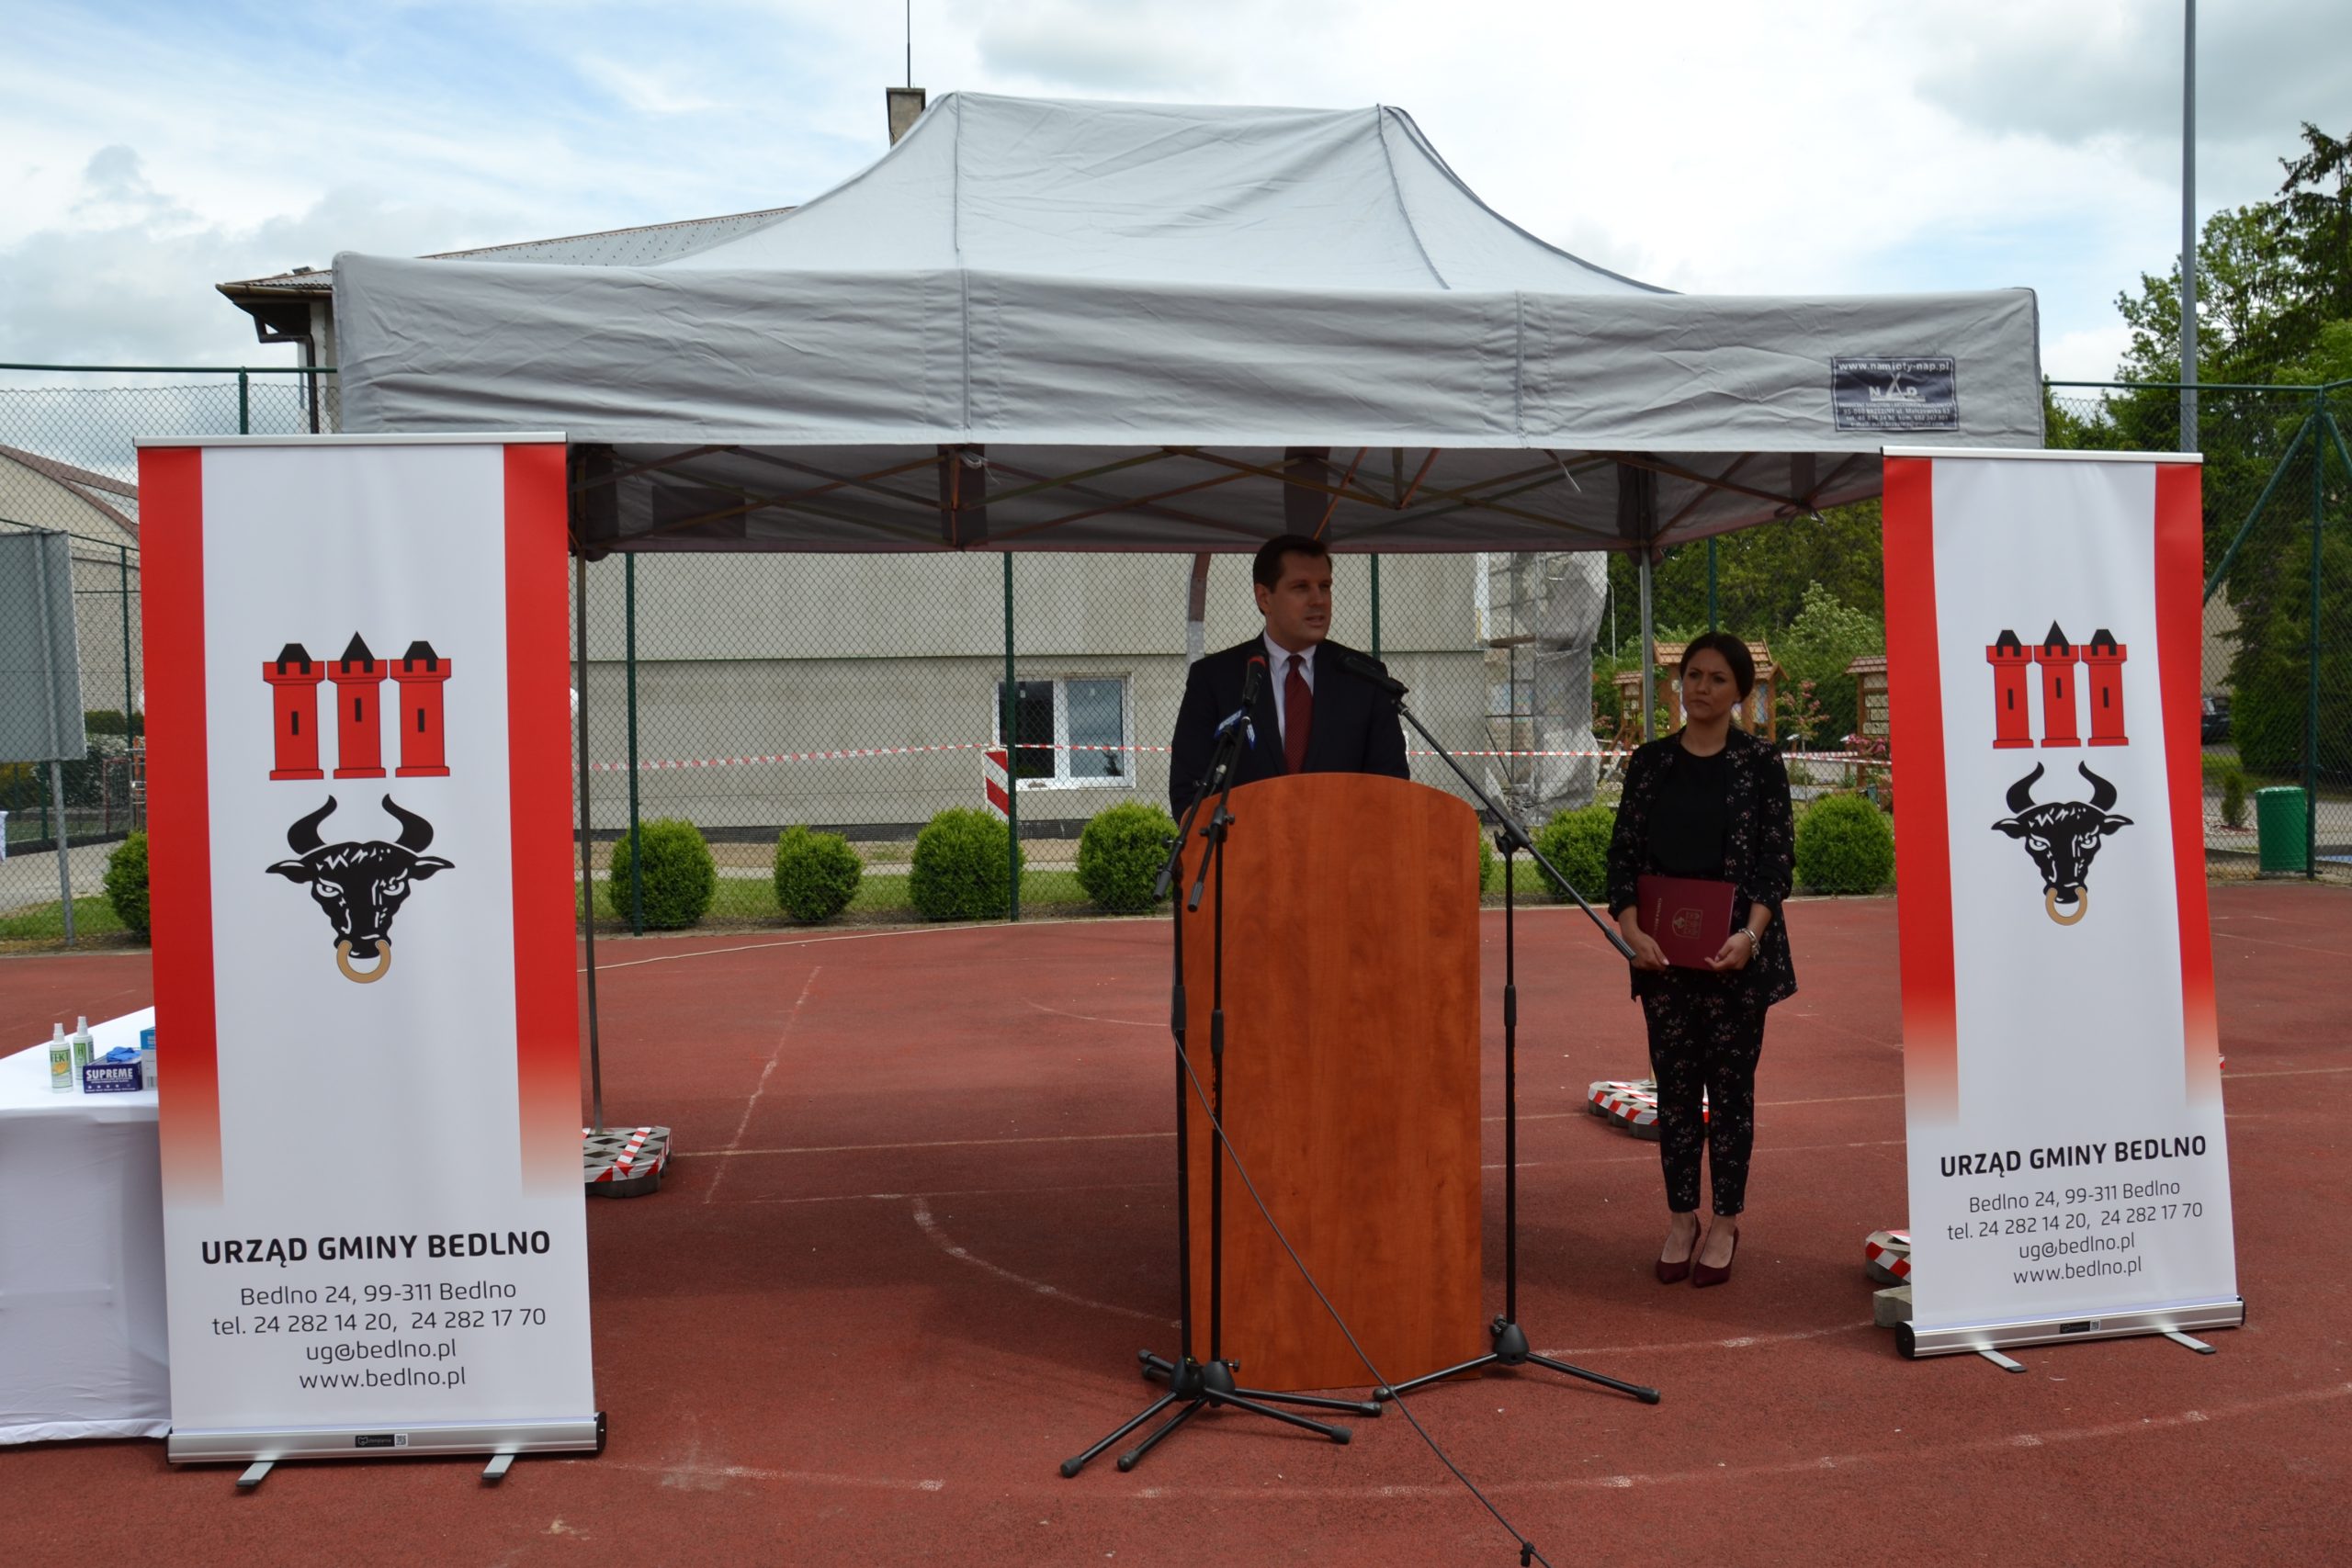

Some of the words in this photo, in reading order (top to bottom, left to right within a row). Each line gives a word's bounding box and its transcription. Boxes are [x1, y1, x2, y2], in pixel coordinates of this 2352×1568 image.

[85, 1067, 133, 1079] SUPREME
[1940, 1150, 2022, 1179] URZĄD
[2029, 1142, 2108, 1170] GMINY
[2114, 1134, 2207, 1163] BEDLNO
[1969, 1193, 2030, 1213] Bedlno
[2035, 1190, 2060, 1209] 24,
[2064, 1184, 2117, 1205] 99-311
[2122, 1179, 2181, 1200] Bedlno
[1947, 1222, 1973, 1241] tel.
[1978, 1220, 1999, 1237] 24
[2005, 1216, 2037, 1235] 282
[2041, 1214, 2060, 1232] 14
[2064, 1213, 2091, 1230] 20,
[2100, 1209, 2121, 1226] 24
[2126, 1205, 2156, 1224] 282
[2161, 1203, 2177, 1221] 17
[2181, 1201, 2203, 1219] 70
[201, 1237, 308, 1269] URZĄD
[317, 1235, 418, 1261] GMINY
[427, 1230, 550, 1258] BEDLNO
[2018, 1231, 2135, 1262] ug@bedlno.pl
[2013, 1255, 2142, 1284] www.bedlno.pl
[241, 1285, 318, 1306] Bedlno
[324, 1285, 356, 1306] 24,
[364, 1283, 432, 1303] 99-311
[439, 1280, 516, 1301] Bedlno
[211, 1315, 246, 1336] tel.
[254, 1315, 280, 1334] 24
[288, 1314, 328, 1333] 282
[334, 1314, 357, 1331] 14
[364, 1313, 397, 1333] 20,
[411, 1311, 437, 1329] 24
[444, 1310, 485, 1329] 282
[491, 1309, 513, 1327] 17
[519, 1307, 546, 1325] 70
[306, 1337, 457, 1365] ug@bedlno.pl
[299, 1366, 466, 1390] www.bedlno.pl
